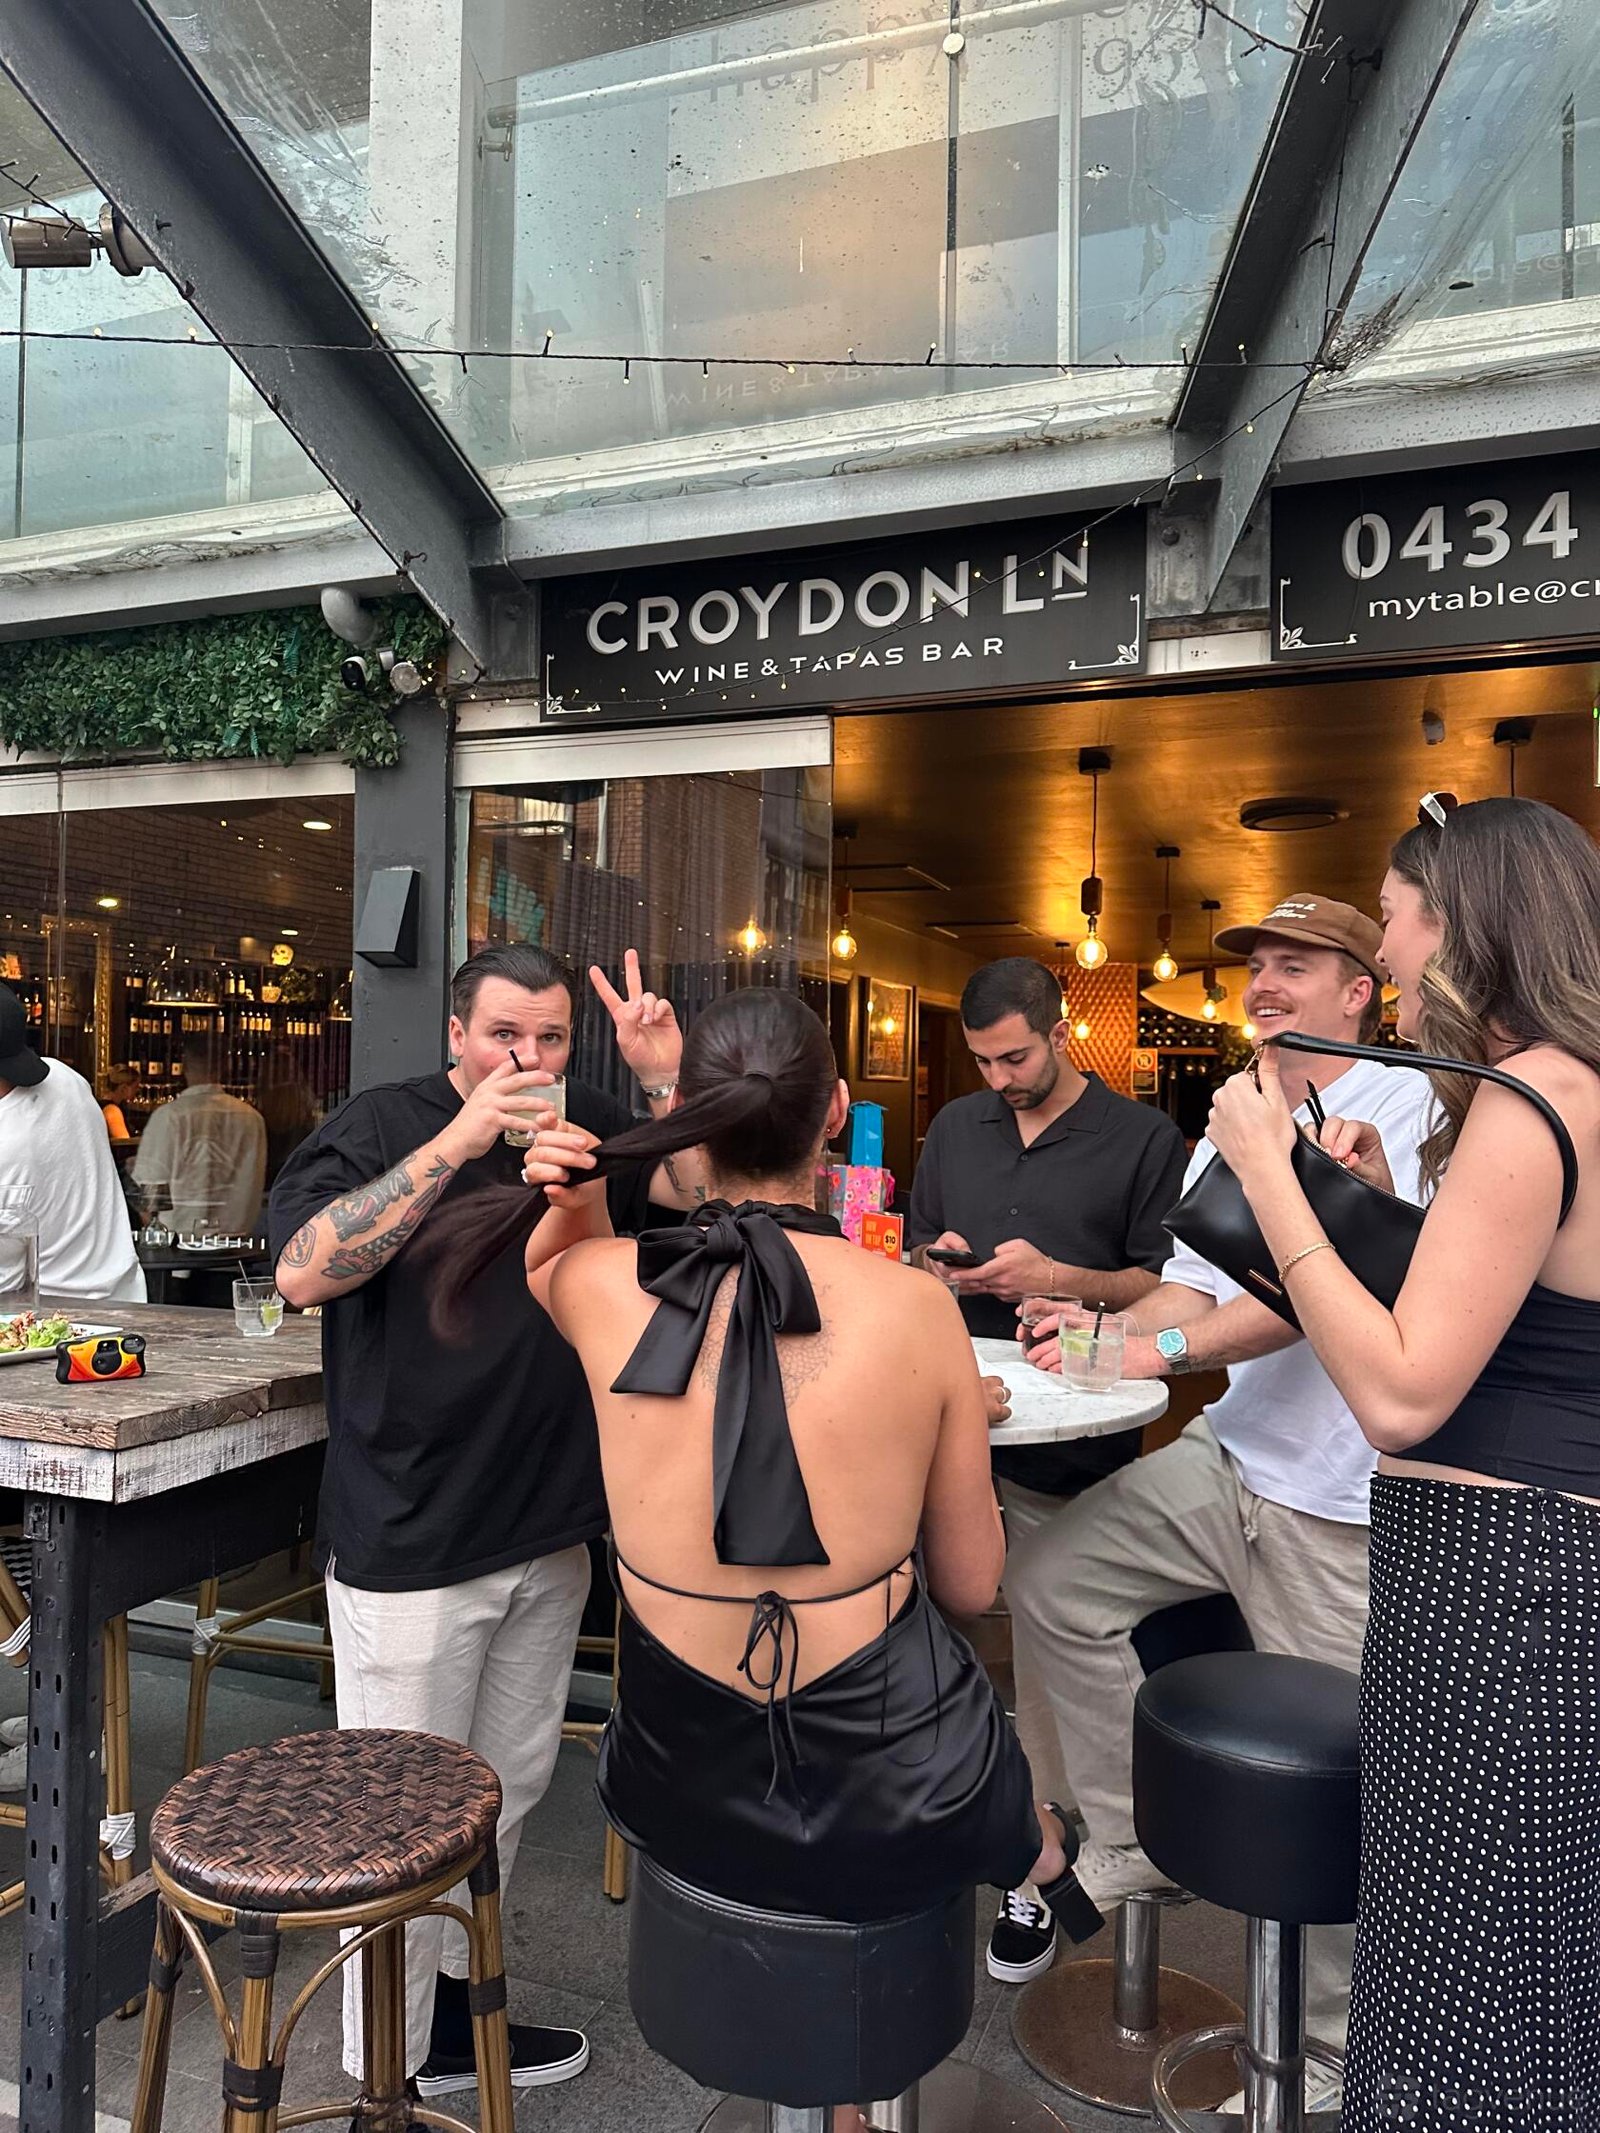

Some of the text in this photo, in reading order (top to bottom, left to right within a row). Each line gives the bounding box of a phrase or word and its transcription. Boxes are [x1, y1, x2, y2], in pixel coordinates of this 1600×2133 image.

[1342, 490, 1578, 580] 0434
[586, 560, 970, 655] CROYDON
[655, 637, 1004, 685] WINE & TAPAS BAR
[885, 1234, 896, 1244] $10
